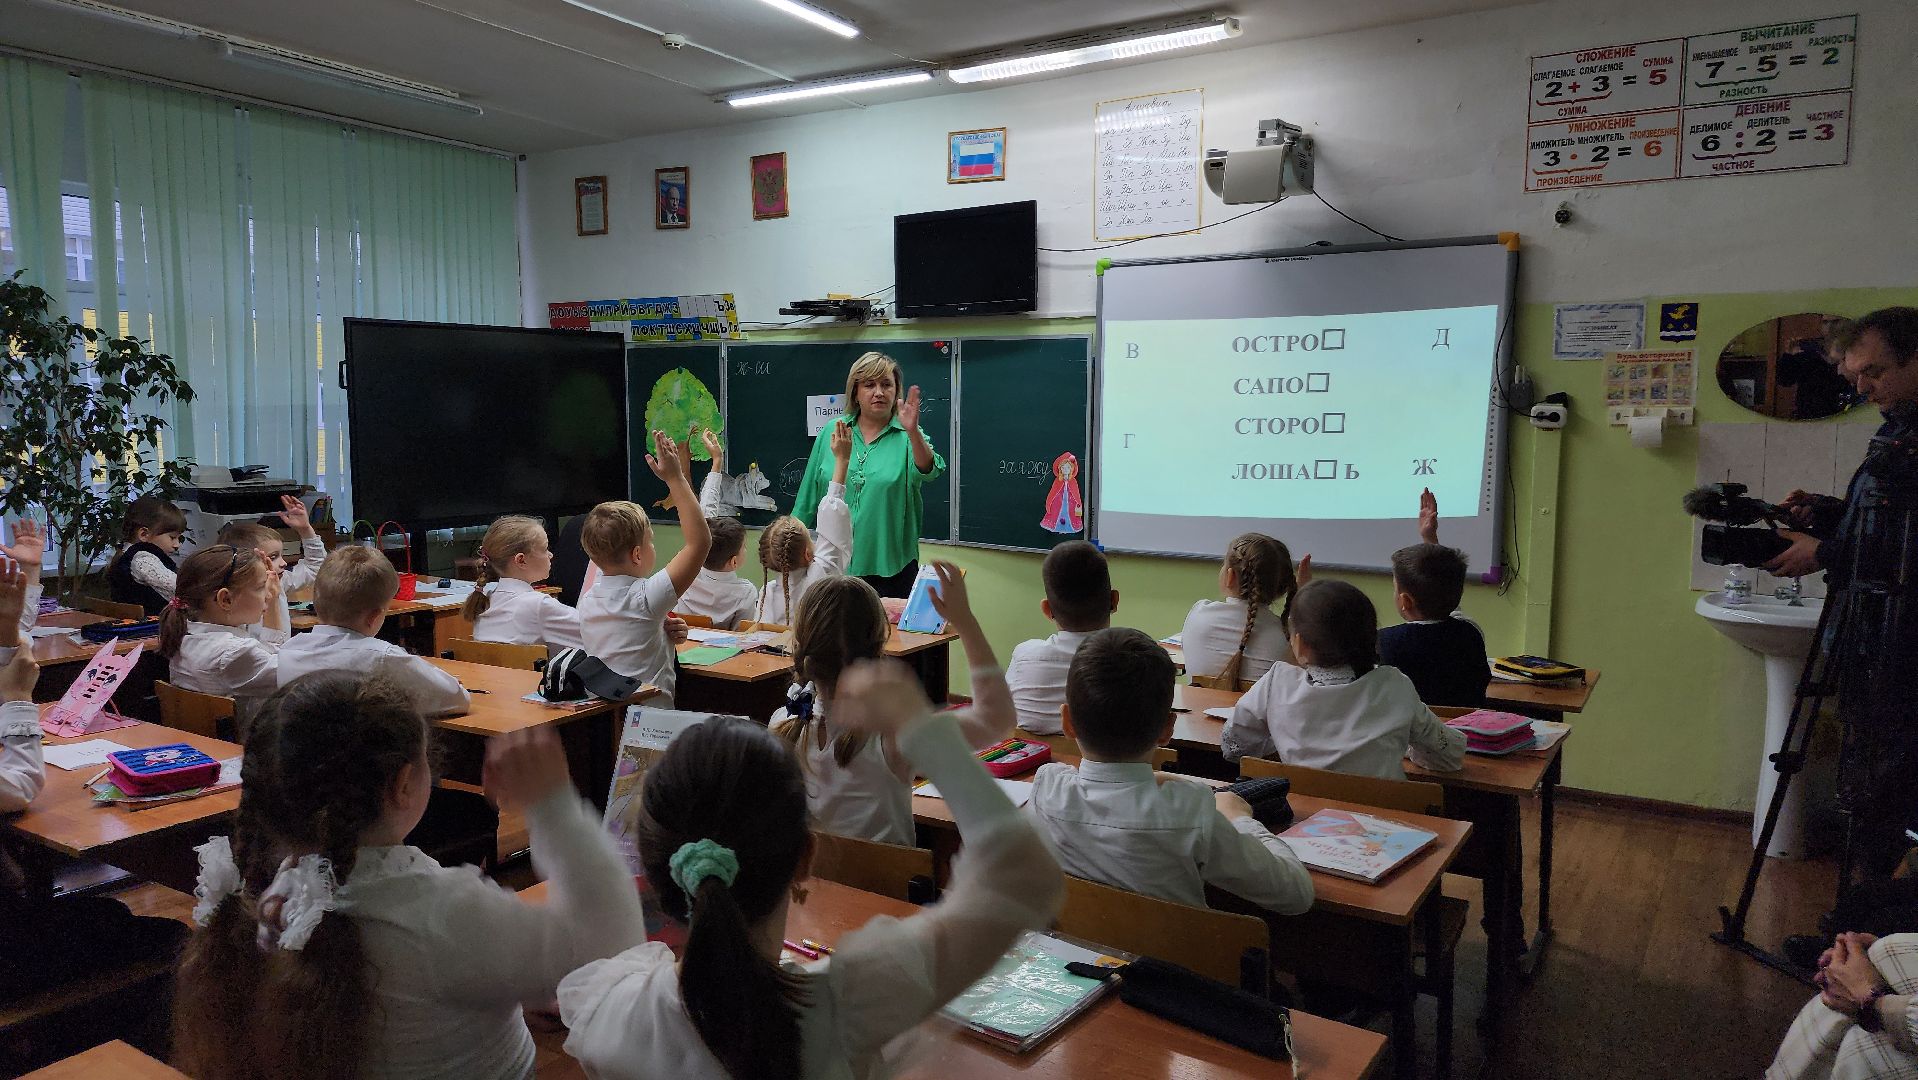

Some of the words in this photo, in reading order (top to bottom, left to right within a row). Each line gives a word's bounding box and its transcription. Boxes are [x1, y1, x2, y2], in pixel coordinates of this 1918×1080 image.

[1741, 23, 1815, 42] ВЫЧИТАНИЕ
[1808, 34, 1855, 47] РАЗНОСТЬ
[1576, 46, 1637, 63] СЛОЖЕНИЕ
[1705, 61, 1724, 79] 7
[1757, 55, 1778, 73] 5
[1822, 47, 1840, 66] 2
[1534, 69, 1575, 81] СЛАГАЕМОЕ
[1579, 62, 1624, 75] СЛАГАЕМОЕ
[1642, 56, 1674, 67] СУММА
[1545, 81, 1563, 98] 2
[1592, 75, 1610, 92] 3
[1649, 69, 1667, 86] 5
[1719, 85, 1768, 98] РАЗНОСТЬ
[1558, 105, 1588, 117] СУММА
[1735, 100, 1791, 118] ДЕЛЕНИЕ
[1568, 117, 1637, 134] УМНОЖЕНИЕ
[1689, 121, 1733, 135] ДЕЛИМОЕ
[1746, 116, 1791, 129] ДЕЛИТЕЛЬ
[1806, 110, 1845, 122] ЧАСТНОЕ
[1577, 133, 1625, 145] МНОЖИТЕЛЬ
[1629, 127, 1679, 140] ПРОИЗВЕДЕНИЕ
[1701, 134, 1720, 152] 6
[1755, 128, 1776, 147] 2
[1814, 123, 1835, 141] 3
[1542, 150, 1561, 167] 3
[1591, 145, 1609, 163] 2
[1643, 140, 1662, 157] 6
[1712, 160, 1755, 171] ЧАСТНОЕ
[1536, 174, 1603, 187] ПРОИЗВЕДЕНИЕ
[1431, 328, 1451, 350] Д
[1125, 343, 1139, 359] В
[1123, 433, 1136, 448] Г
[1412, 458, 1438, 476] Ж
